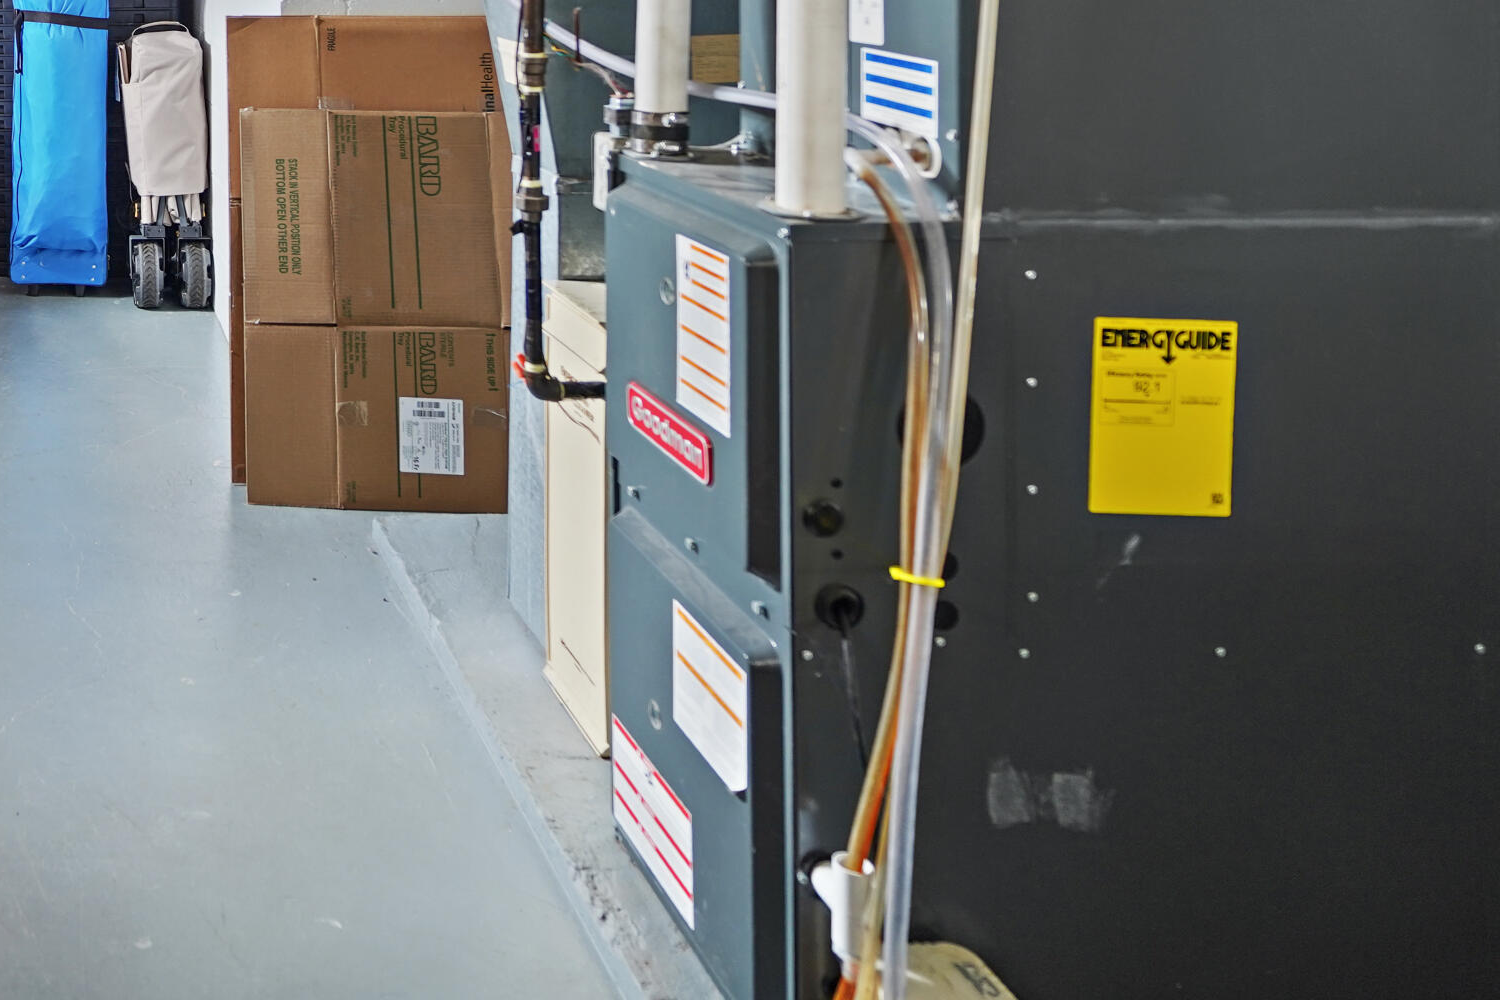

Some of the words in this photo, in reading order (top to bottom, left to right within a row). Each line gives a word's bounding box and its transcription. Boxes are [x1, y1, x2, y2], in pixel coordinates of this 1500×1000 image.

[327, 27, 336, 51] FRAGILE
[479, 52, 496, 113] inalHealth
[388, 116, 397, 133] Tray
[398, 115, 409, 160] Procedural
[416, 115, 441, 196] BARD
[275, 158, 286, 195] BOTTOM
[288, 159, 298, 180] STACK
[288, 181, 298, 189] IN
[276, 197, 287, 221] OPEN
[289, 190, 300, 222] VERTICAL
[277, 223, 288, 253] OTHER
[290, 224, 301, 256] POSITION
[278, 255, 289, 274] END
[291, 257, 302, 275] ONLY
[397, 332, 405, 346] Tray
[404, 331, 412, 367] Procedural
[486, 339, 494, 355] THIS
[419, 331, 437, 395] BARD
[486, 357, 495, 374] SIDE
[487, 376, 496, 387] UP
[630, 395, 703, 470] Goodman
